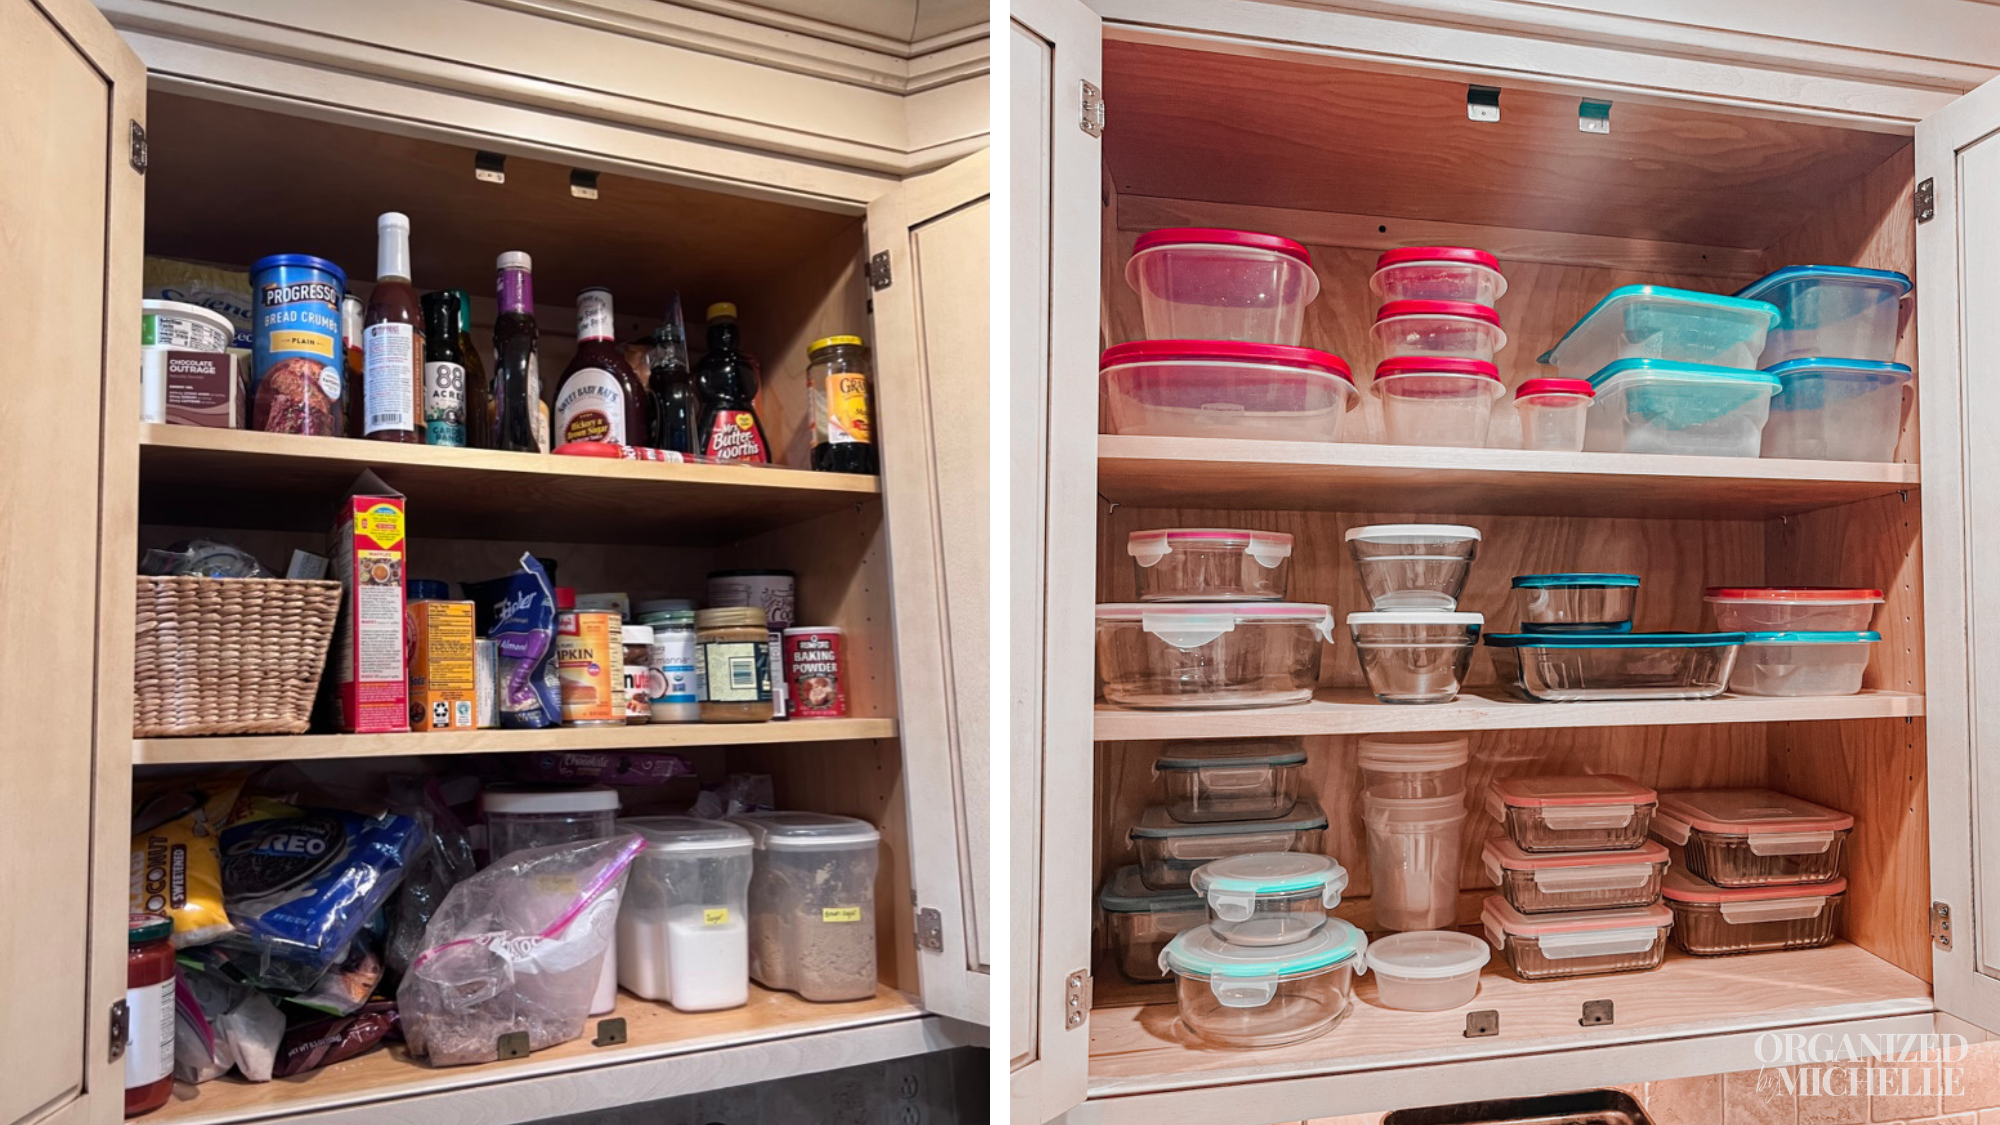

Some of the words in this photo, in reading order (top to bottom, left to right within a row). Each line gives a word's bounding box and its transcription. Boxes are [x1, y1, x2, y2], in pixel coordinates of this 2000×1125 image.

[267, 284, 336, 305] PROGRESSO
[264, 310, 297, 327] BREAD
[301, 311, 338, 334] CRUMBS
[291, 338, 315, 346] PLAIN
[169, 359, 213, 367] CHOCOLATE
[169, 365, 216, 374] OUTRAGE
[436, 364, 463, 391] 88
[577, 385, 597, 397] BABY
[793, 651, 835, 661] BAKING
[792, 663, 838, 673] POWDER
[227, 834, 327, 855] OREO
[146, 836, 168, 915] OCONUT
[172, 848, 185, 902] SWEETENED
